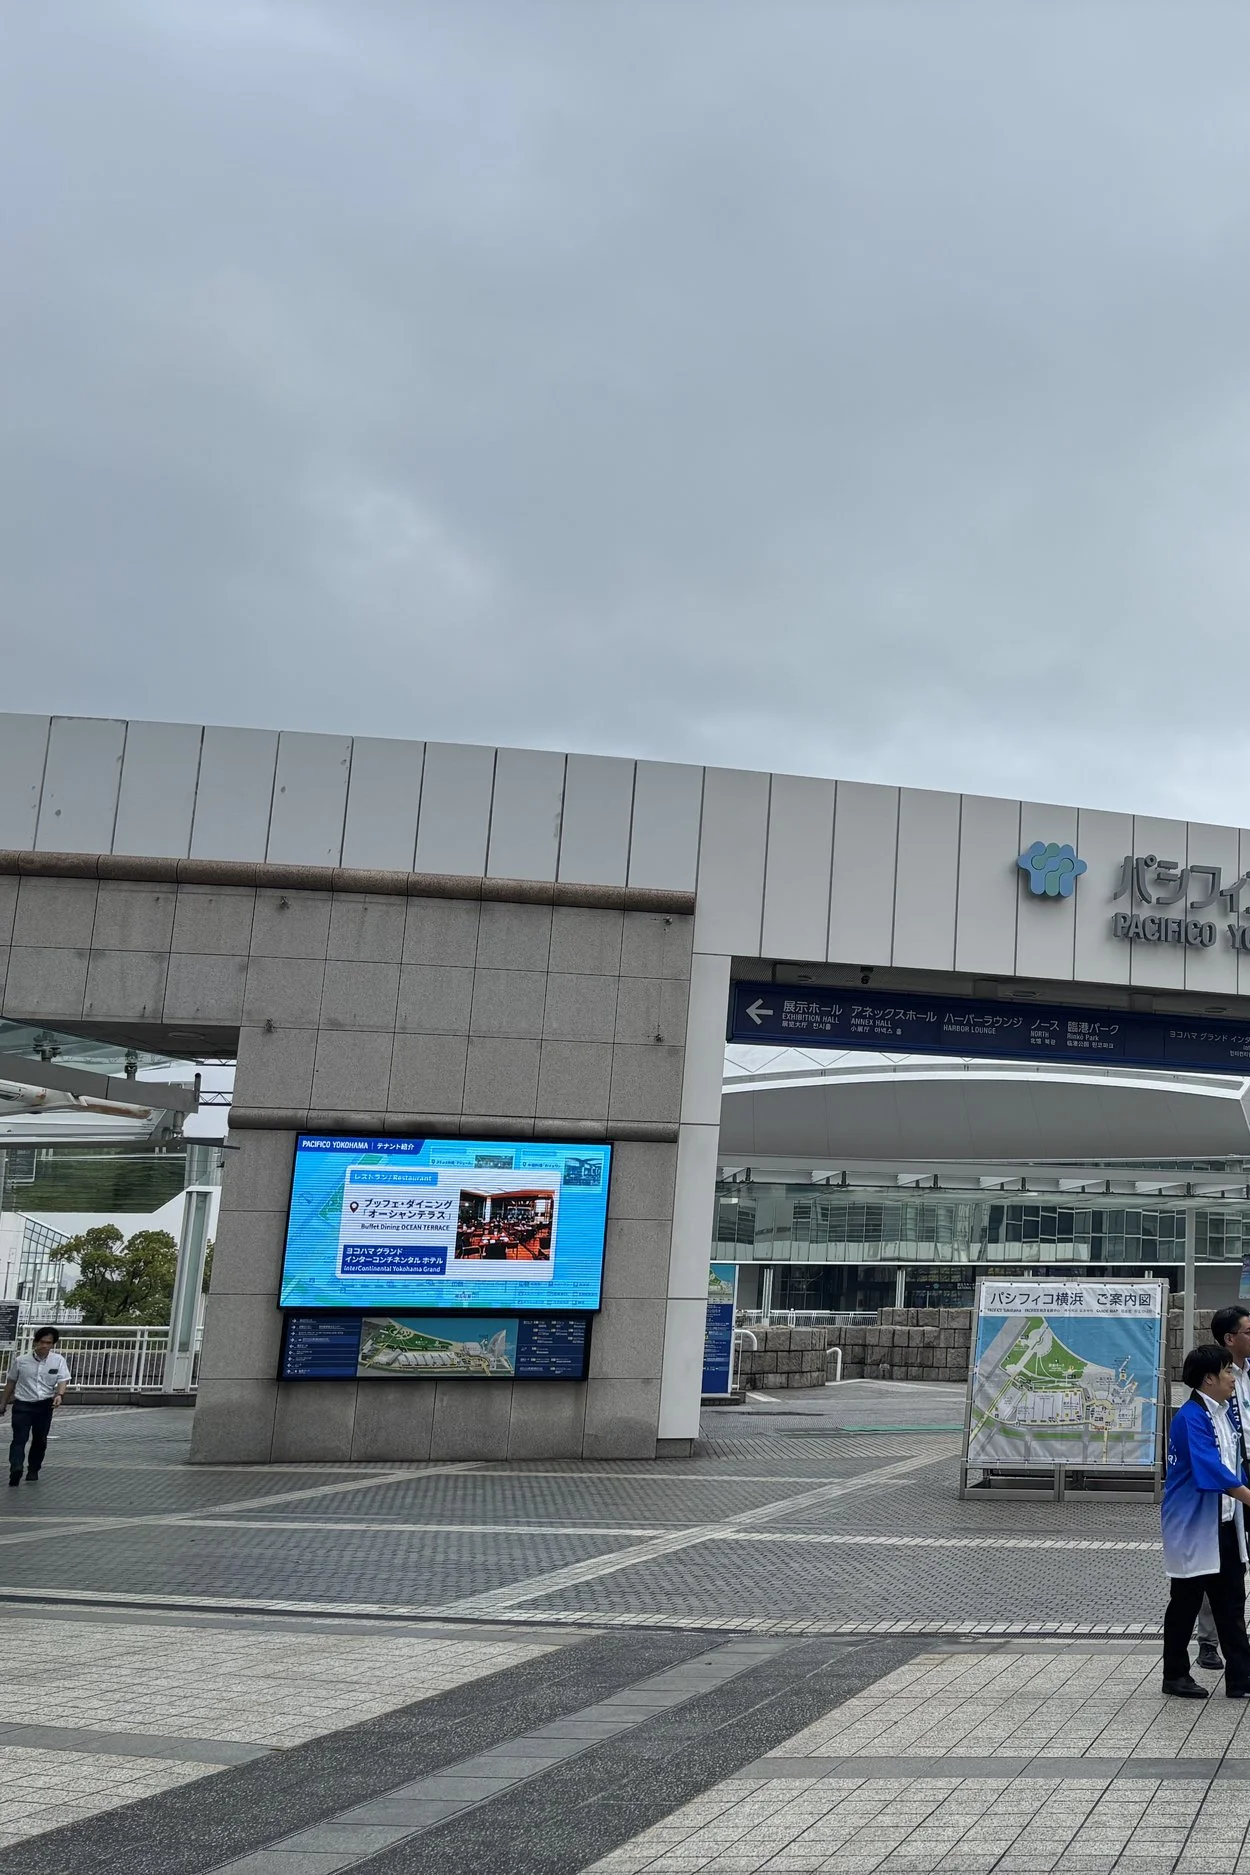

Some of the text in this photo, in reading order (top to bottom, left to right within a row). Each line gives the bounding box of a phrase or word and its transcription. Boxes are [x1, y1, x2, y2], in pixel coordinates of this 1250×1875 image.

[1112, 912, 1217, 948] PACIFICO
[783, 1000, 842, 1016] 展示ホール
[851, 1005, 937, 1022] アネックスホール
[782, 1013, 840, 1024] EXHIBITION HALL
[851, 1018, 874, 1026] ANNEX
[944, 1013, 1023, 1028] ハーバーラウンジ
[943, 1025, 997, 1035] HARBOR LOUNGE
[1031, 1019, 1060, 1031] ノース
[1067, 1021, 1119, 1035] 臨港パーク
[1030, 1030, 1050, 1038] NORTH
[1169, 1030, 1198, 1040] ヨコハマ
[1200, 1032, 1228, 1042] グランド
[302, 1140, 415, 1151] PACIFICO YOKOHAMA テナント紹介
[364, 1198, 453, 1209] ブッフェ・ダイニング
[363, 1209, 452, 1220] 「オーシャンテラス」
[346, 1247, 376, 1255] ヨコハマ
[345, 1256, 420, 1264] インターコンチネンタル
[990, 1292, 1151, 1307] パシフィコ横浜 ご案内図
